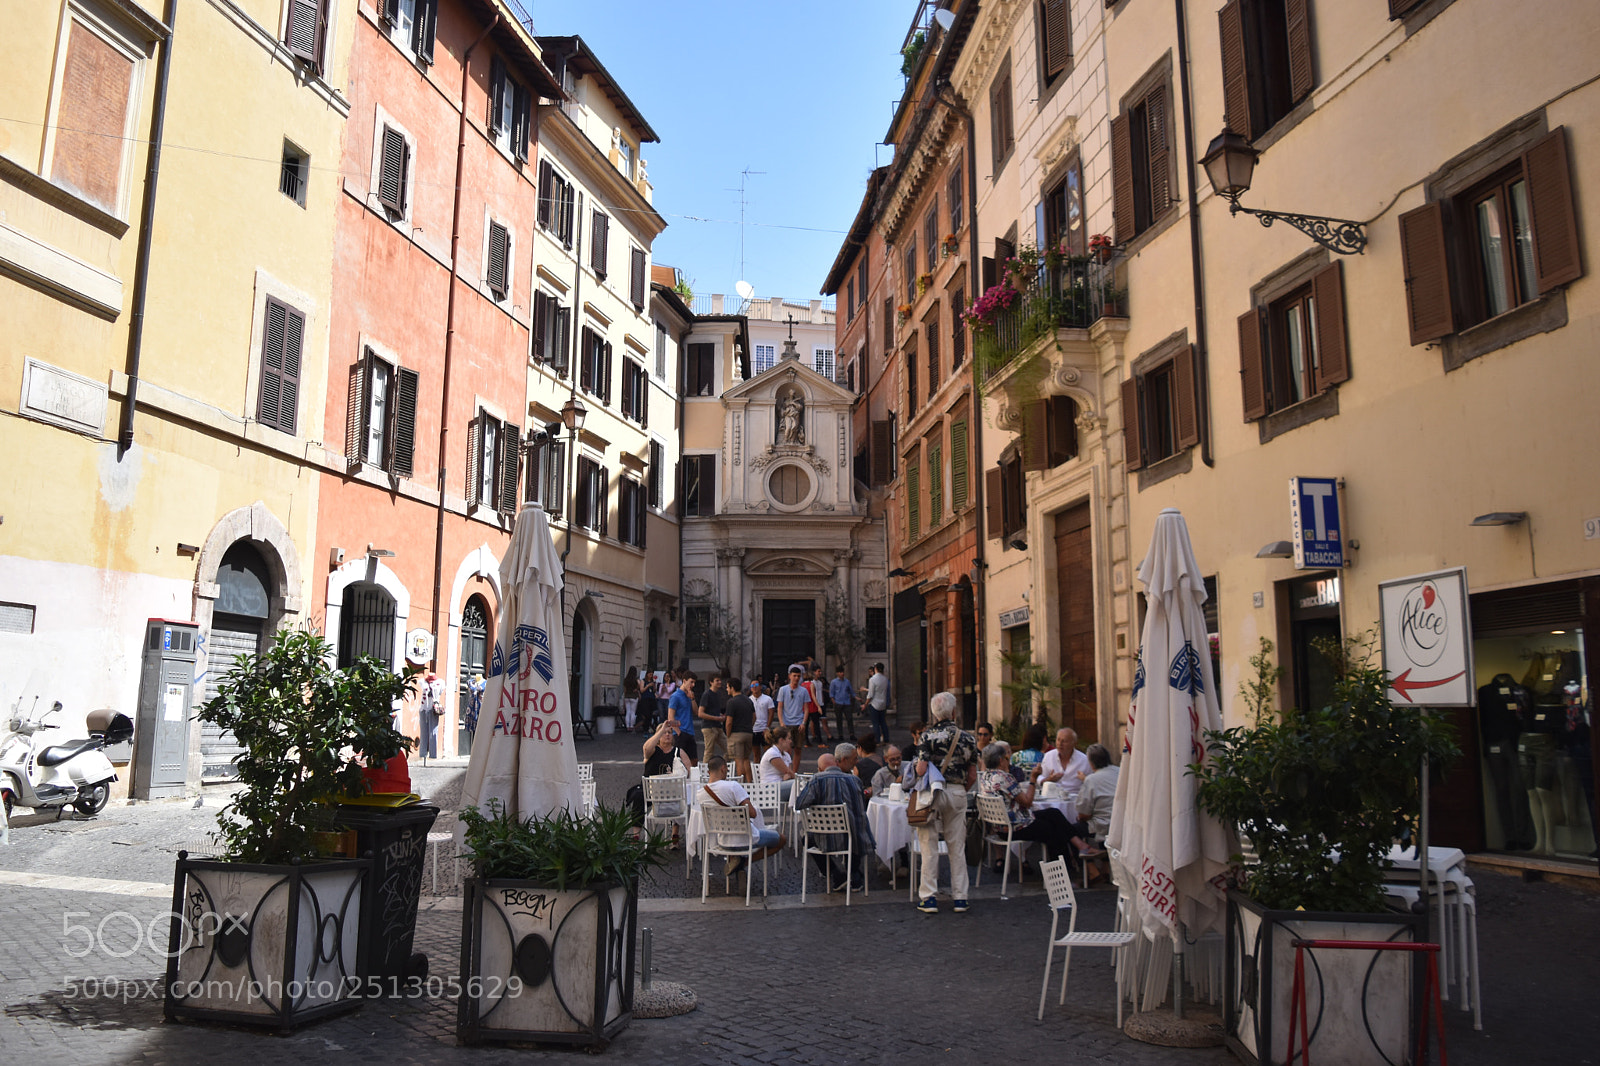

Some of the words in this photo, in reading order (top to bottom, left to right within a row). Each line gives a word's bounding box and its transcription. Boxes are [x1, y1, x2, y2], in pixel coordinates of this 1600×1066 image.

[1289, 478, 1300, 560] TABACCHI
[1302, 483, 1332, 540] T
[1586, 519, 1600, 538] 9
[1305, 552, 1341, 564] TABACCHI
[1402, 597, 1443, 649] Alice
